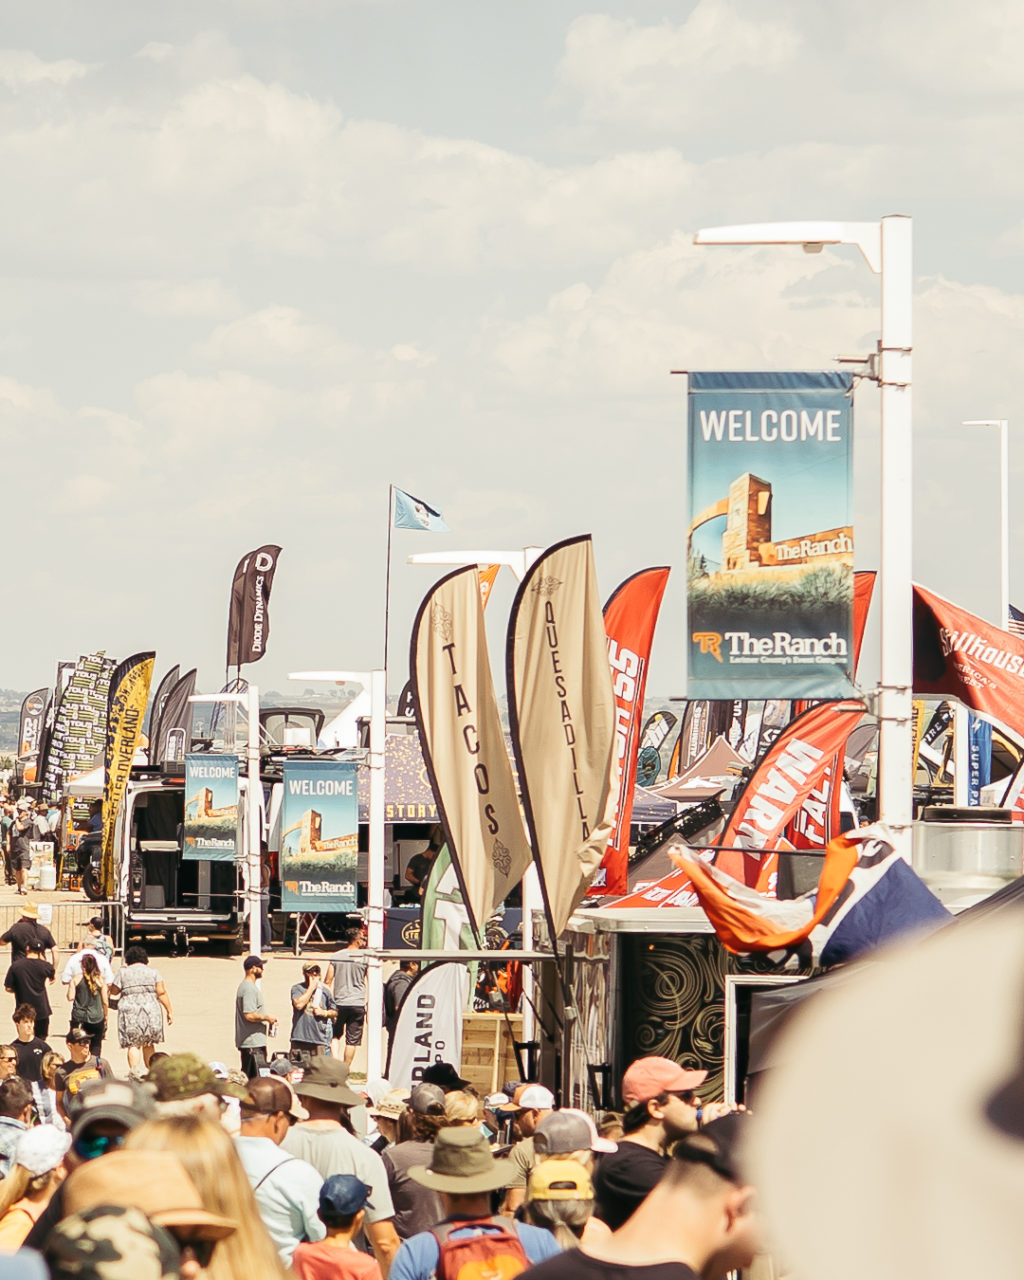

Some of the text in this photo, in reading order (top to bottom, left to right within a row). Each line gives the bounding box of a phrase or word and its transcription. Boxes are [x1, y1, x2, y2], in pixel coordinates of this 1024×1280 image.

[699, 410, 842, 442] WELCOME
[252, 576, 265, 652] DIODE DYNAMICS
[442, 642, 500, 836] TACOS
[971, 745, 980, 785] SUPER
[189, 766, 235, 779] WELCOME
[289, 780, 353, 796] WELCOME
[733, 737, 825, 861] WARN
[386, 803, 437, 818] STORY
[802, 767, 830, 845] FAC
[411, 994, 436, 1088] RLAND
